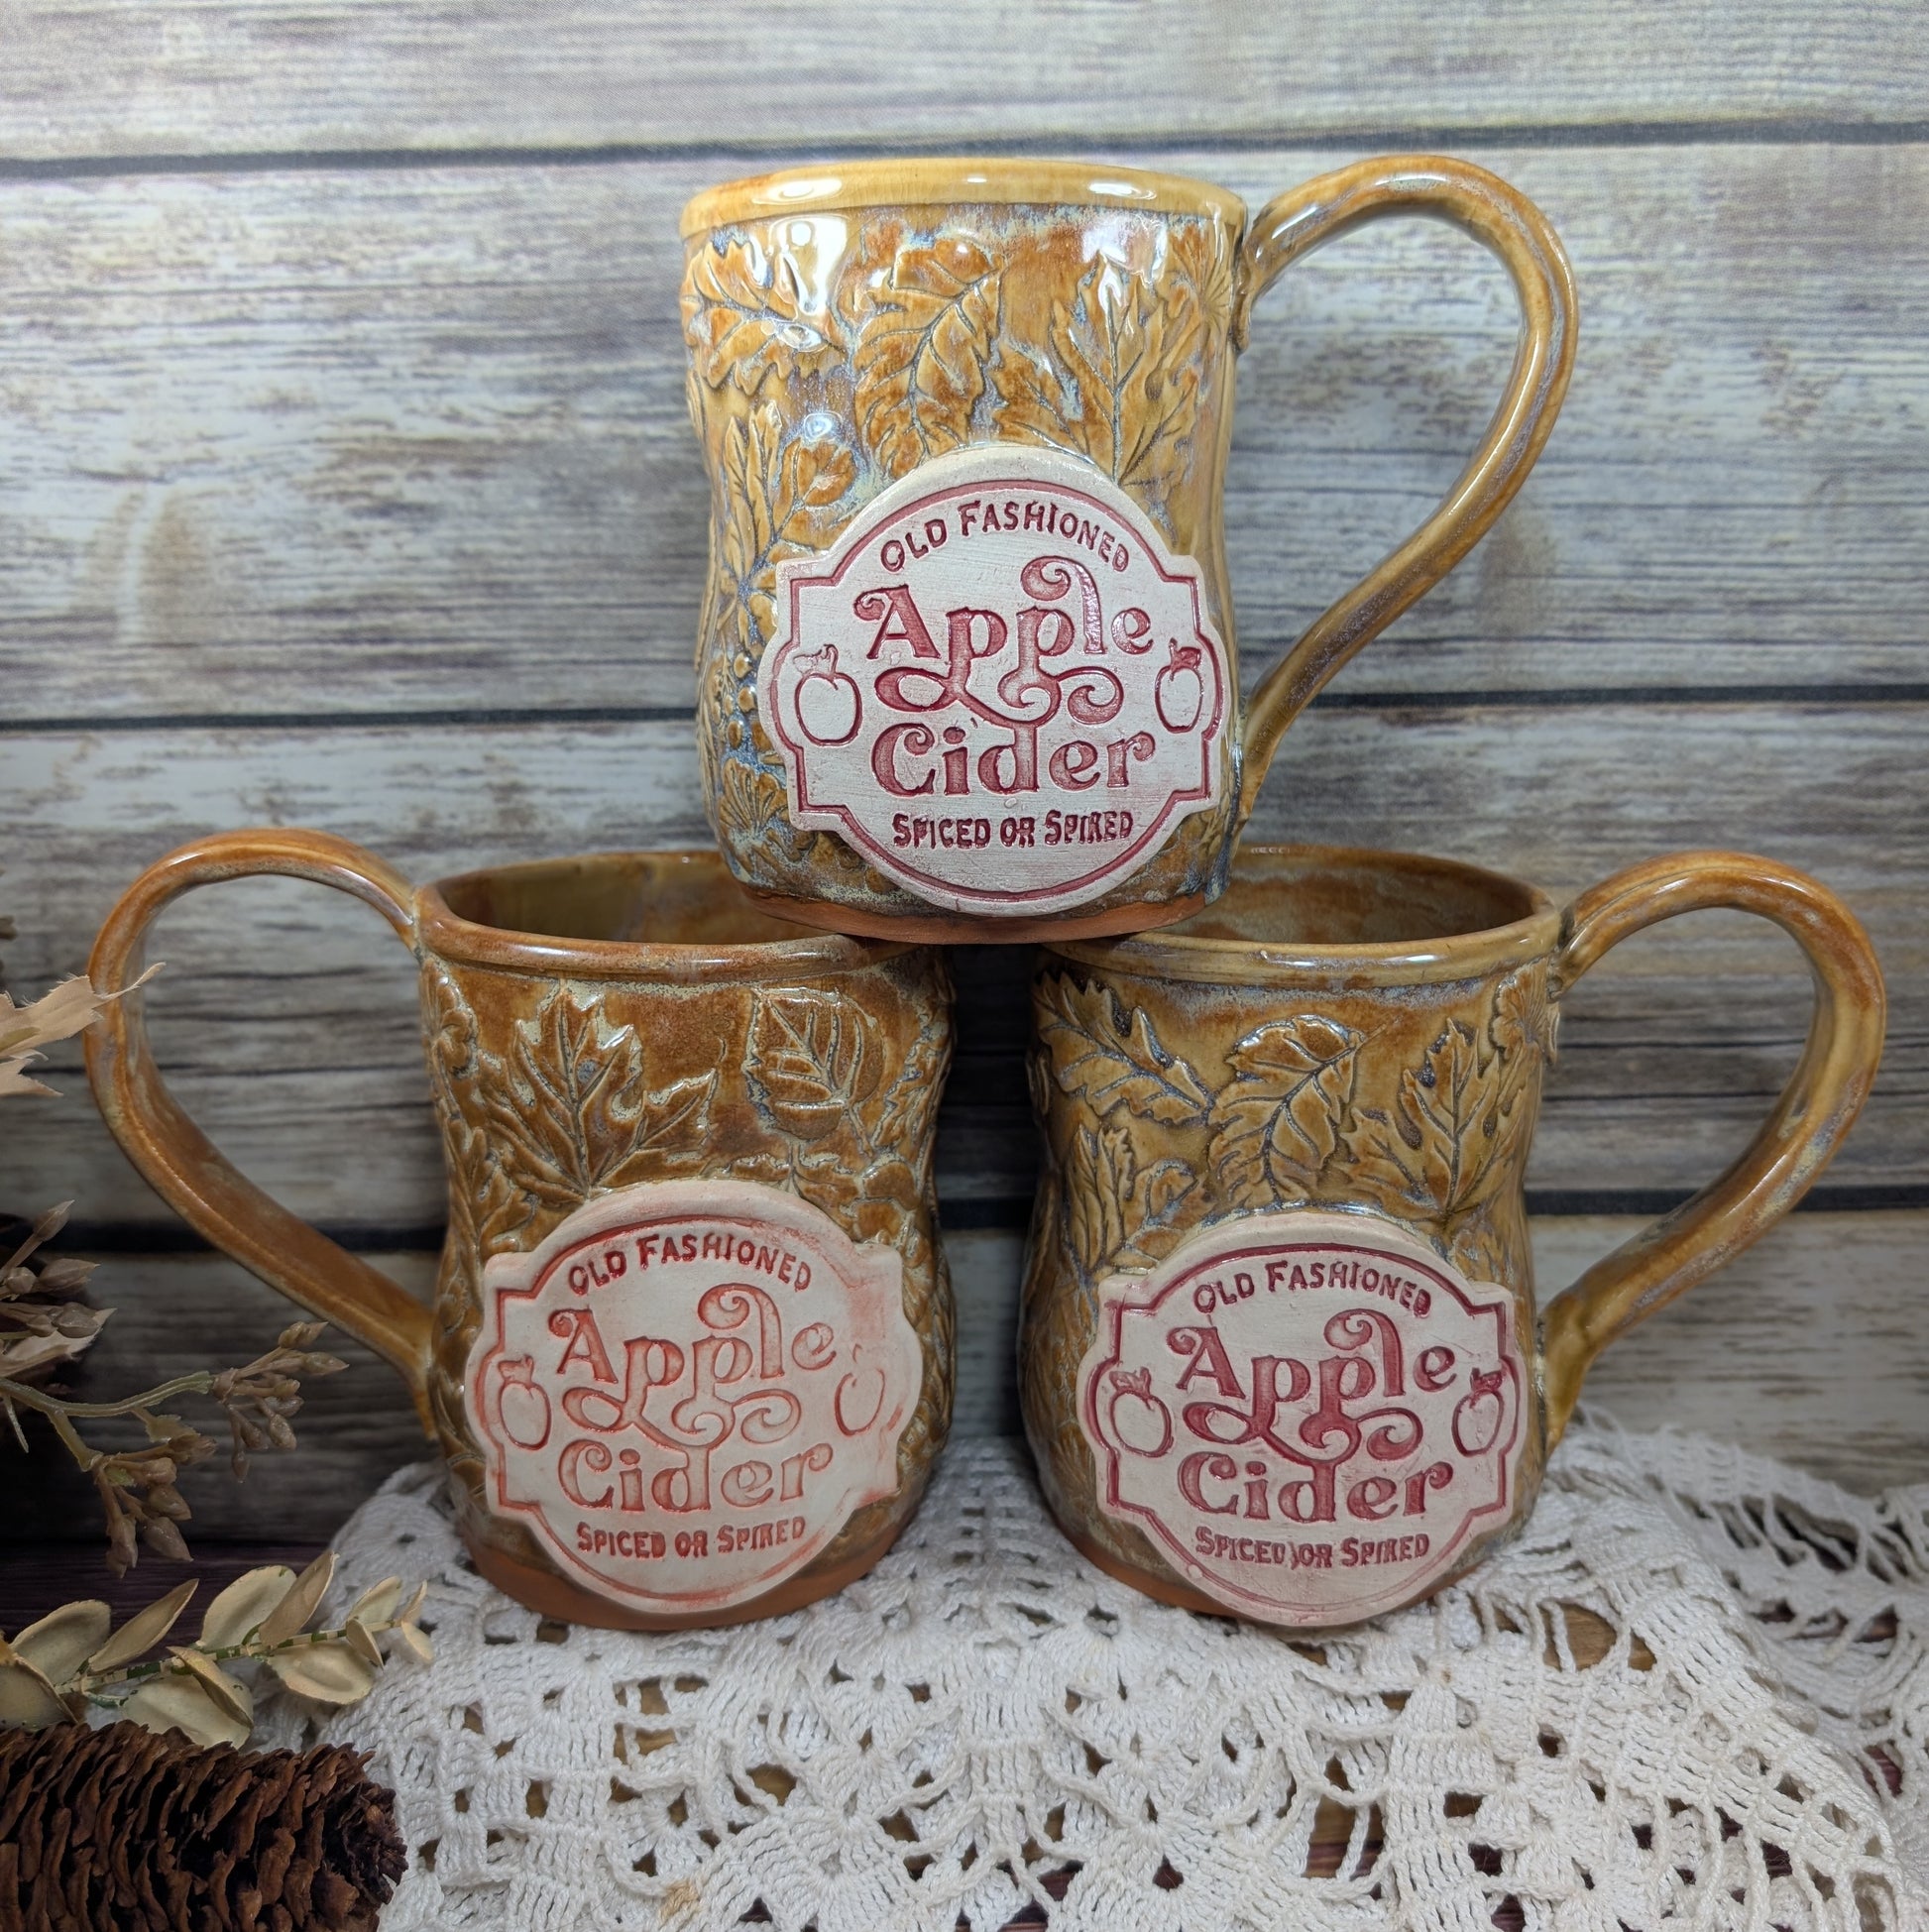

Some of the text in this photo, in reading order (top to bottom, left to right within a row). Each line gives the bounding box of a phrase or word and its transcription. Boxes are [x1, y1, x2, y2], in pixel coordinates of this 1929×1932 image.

[881, 501, 1130, 572] OLD FASHIONED
[854, 555, 1153, 725] Apple
[871, 722, 1156, 795] Cider
[893, 810, 1133, 849] SPICED OR SPIKED
[568, 1232, 812, 1296] OLD FASHIONED
[1192, 1260, 1431, 1316] OLD FASHIONED
[548, 1283, 836, 1448] Apple
[1166, 1308, 1456, 1465] Apple
[558, 1439, 833, 1512] Cider
[1178, 1451, 1453, 1523] Cider
[577, 1517, 806, 1558] SPICED OR SPIKED
[1195, 1527, 1429, 1567] SPICED OR SPIKED
